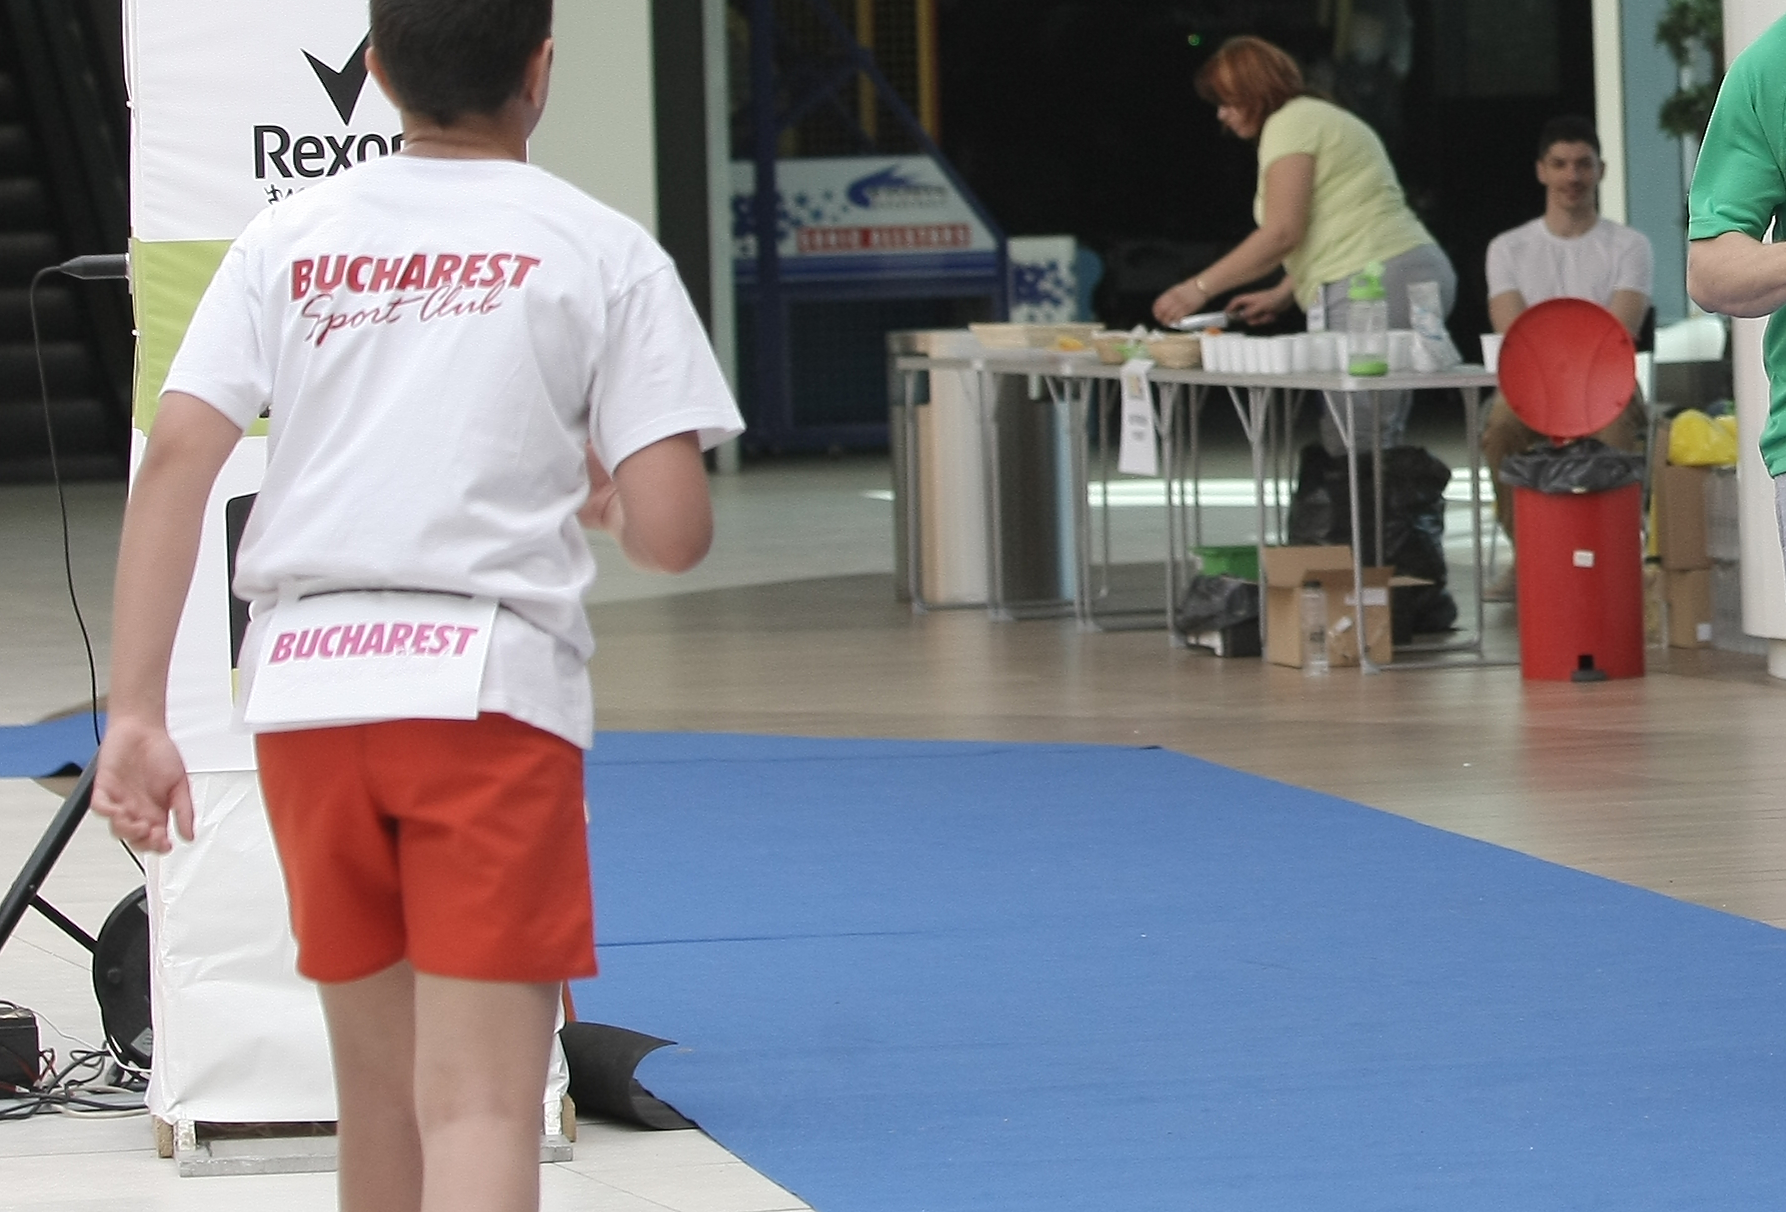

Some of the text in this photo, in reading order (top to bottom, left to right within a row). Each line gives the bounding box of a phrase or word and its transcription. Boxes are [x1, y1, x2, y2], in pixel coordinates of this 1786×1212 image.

[290, 251, 541, 302] BUCHAREST
[301, 280, 505, 347] Sport Club
[268, 622, 479, 665] BUCHAREST
